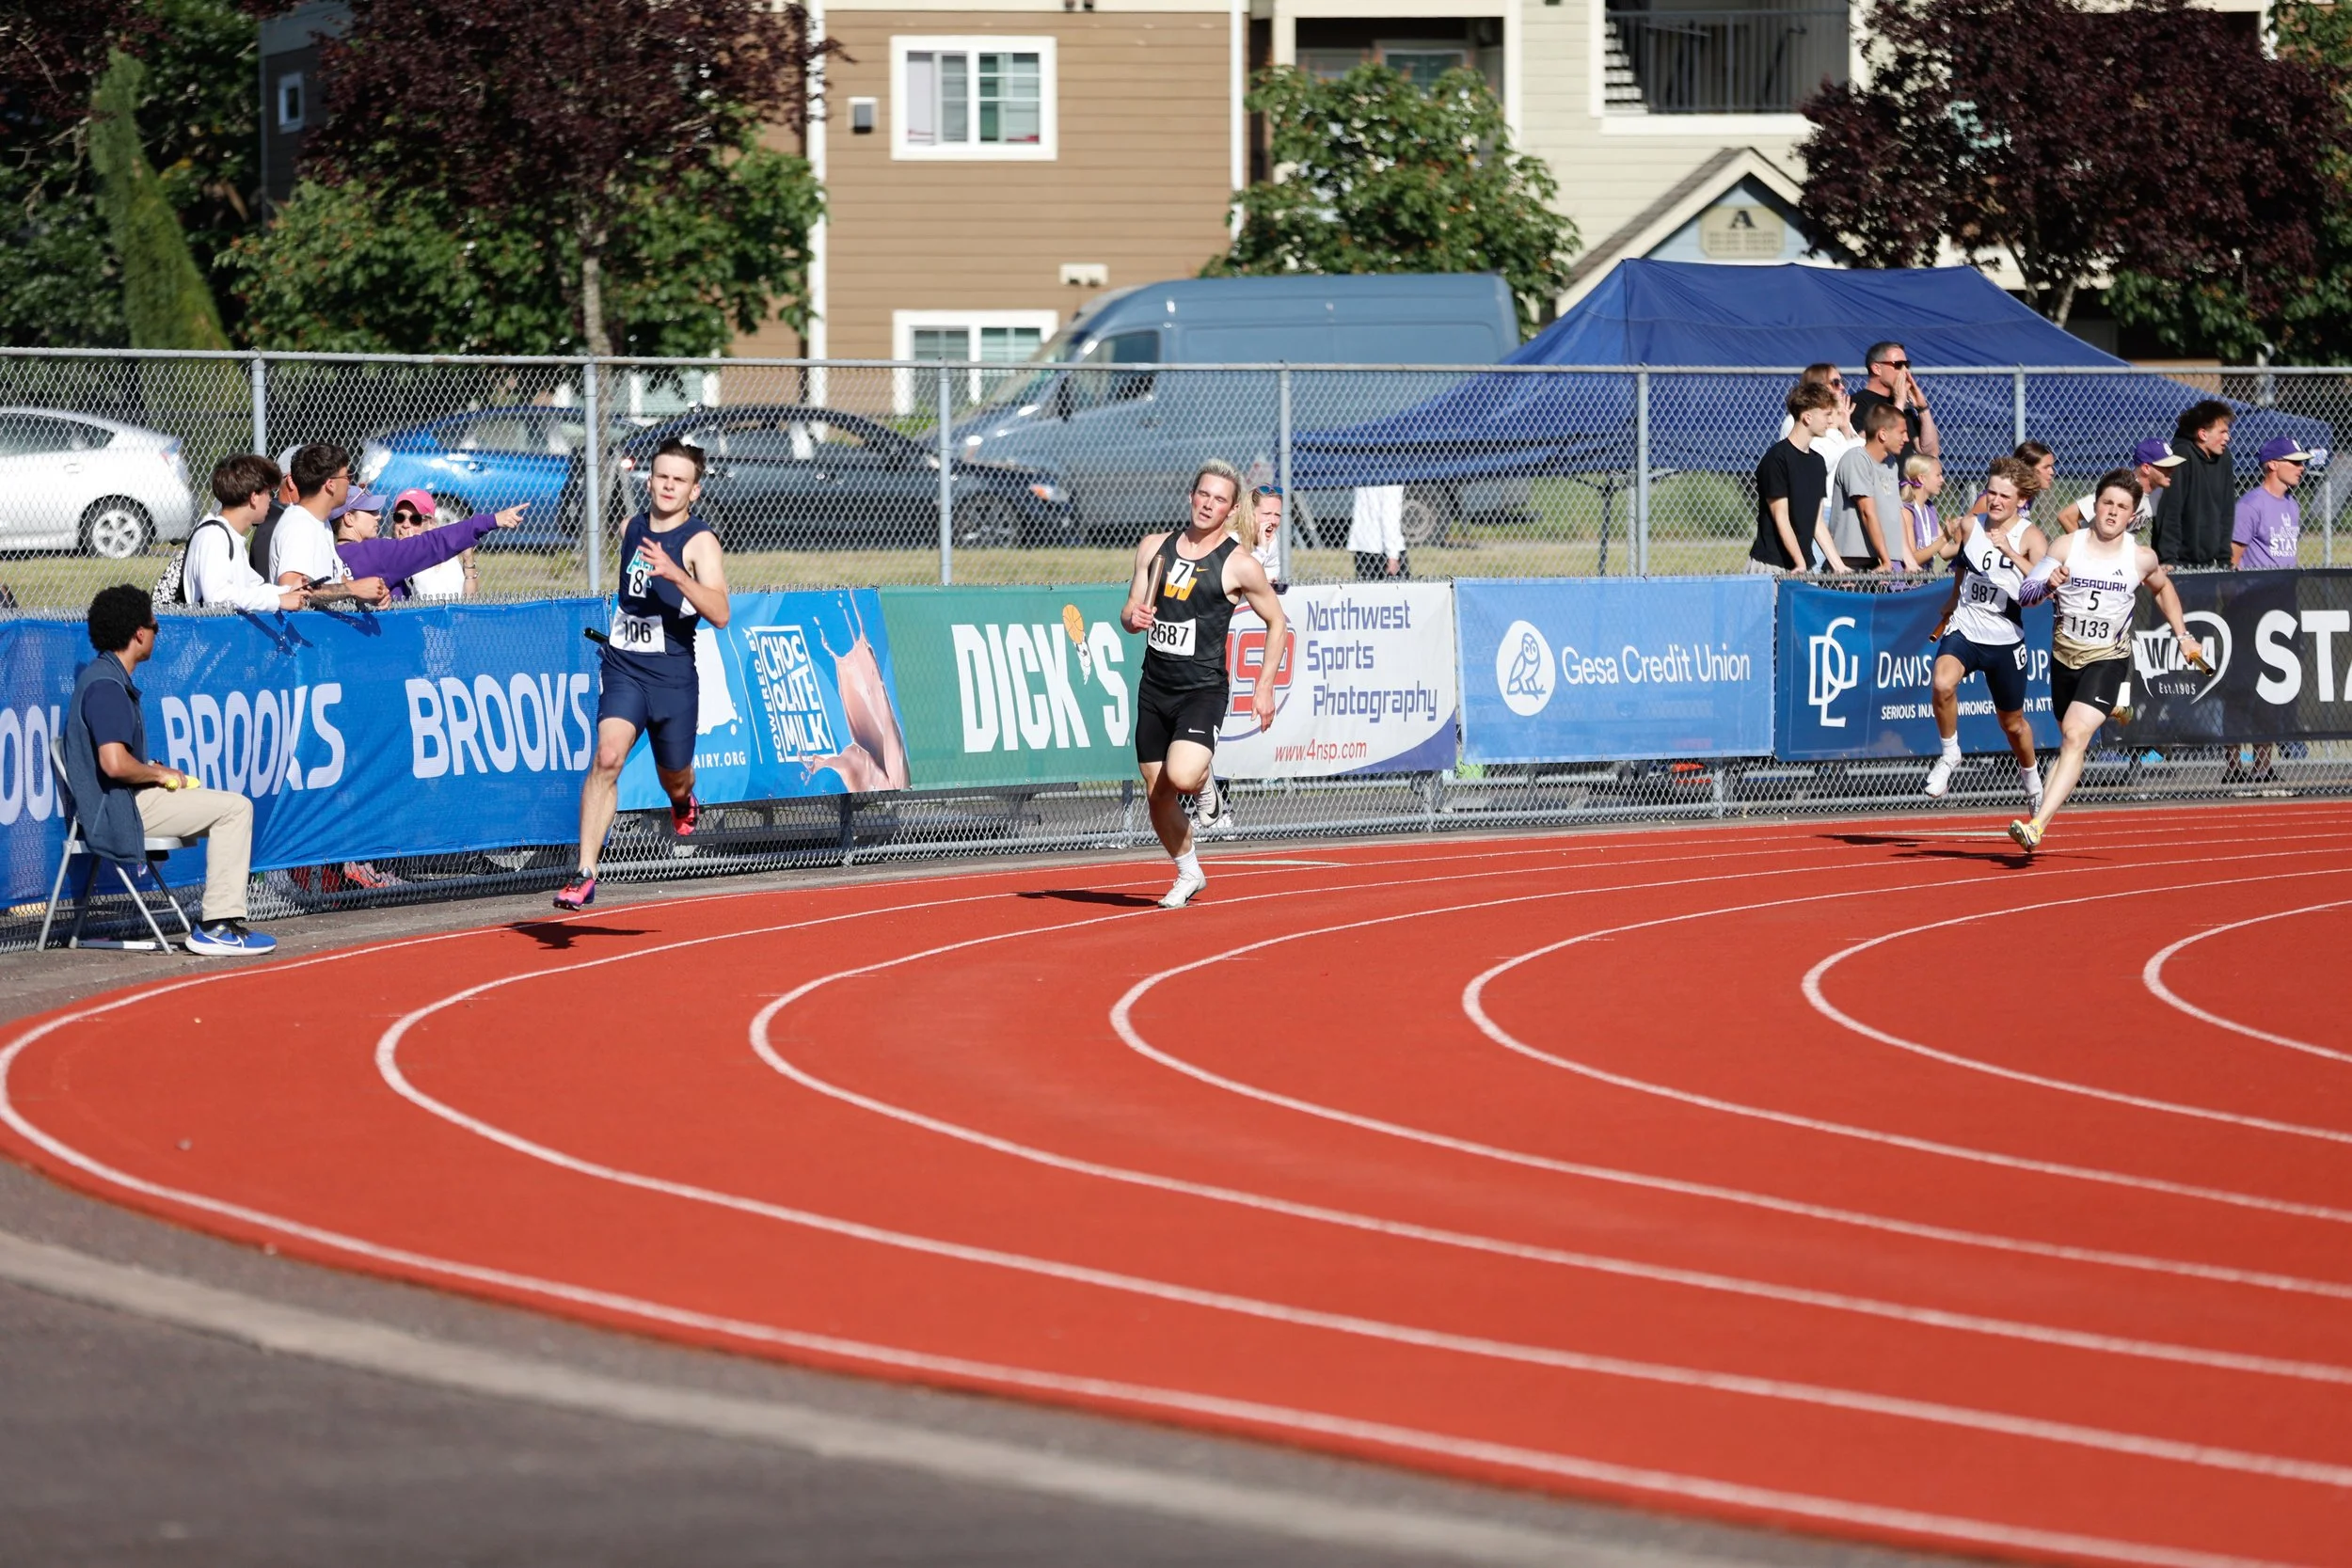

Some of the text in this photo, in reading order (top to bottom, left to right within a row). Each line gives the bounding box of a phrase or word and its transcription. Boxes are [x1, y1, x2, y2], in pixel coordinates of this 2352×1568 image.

[1729, 210, 1756, 229] A
[1174, 562, 1190, 584] 7
[1982, 550, 1993, 571] 6
[632, 569, 644, 594] 8
[1971, 582, 1998, 605] 987
[2071, 577, 2127, 593] ISSAQUAH
[1306, 597, 1411, 631] Northwest
[2088, 590, 2101, 611] 5
[623, 619, 652, 643] 106
[1151, 620, 1189, 647] 2687
[2070, 616, 2109, 639] 1133
[760, 635, 806, 680] CHOC
[1307, 640, 1375, 679] Sports
[1561, 642, 1751, 685] Gesa Credit Union
[1877, 651, 1932, 689] DAVIS
[2255, 610, 2352, 705] ST
[742, 626, 787, 764] POWERED BY
[772, 663, 821, 712] OLATE
[951, 611, 1129, 753] DICK'S
[1312, 680, 1438, 723] Photography
[1881, 705, 1916, 721] SERIOUS
[405, 672, 592, 779] BROOKS
[780, 713, 833, 752] MILK
[160, 683, 345, 799] BROOKS
[1274, 738, 1367, 763] www.4nsp.com
[693, 751, 747, 769] AIRY.ORG
